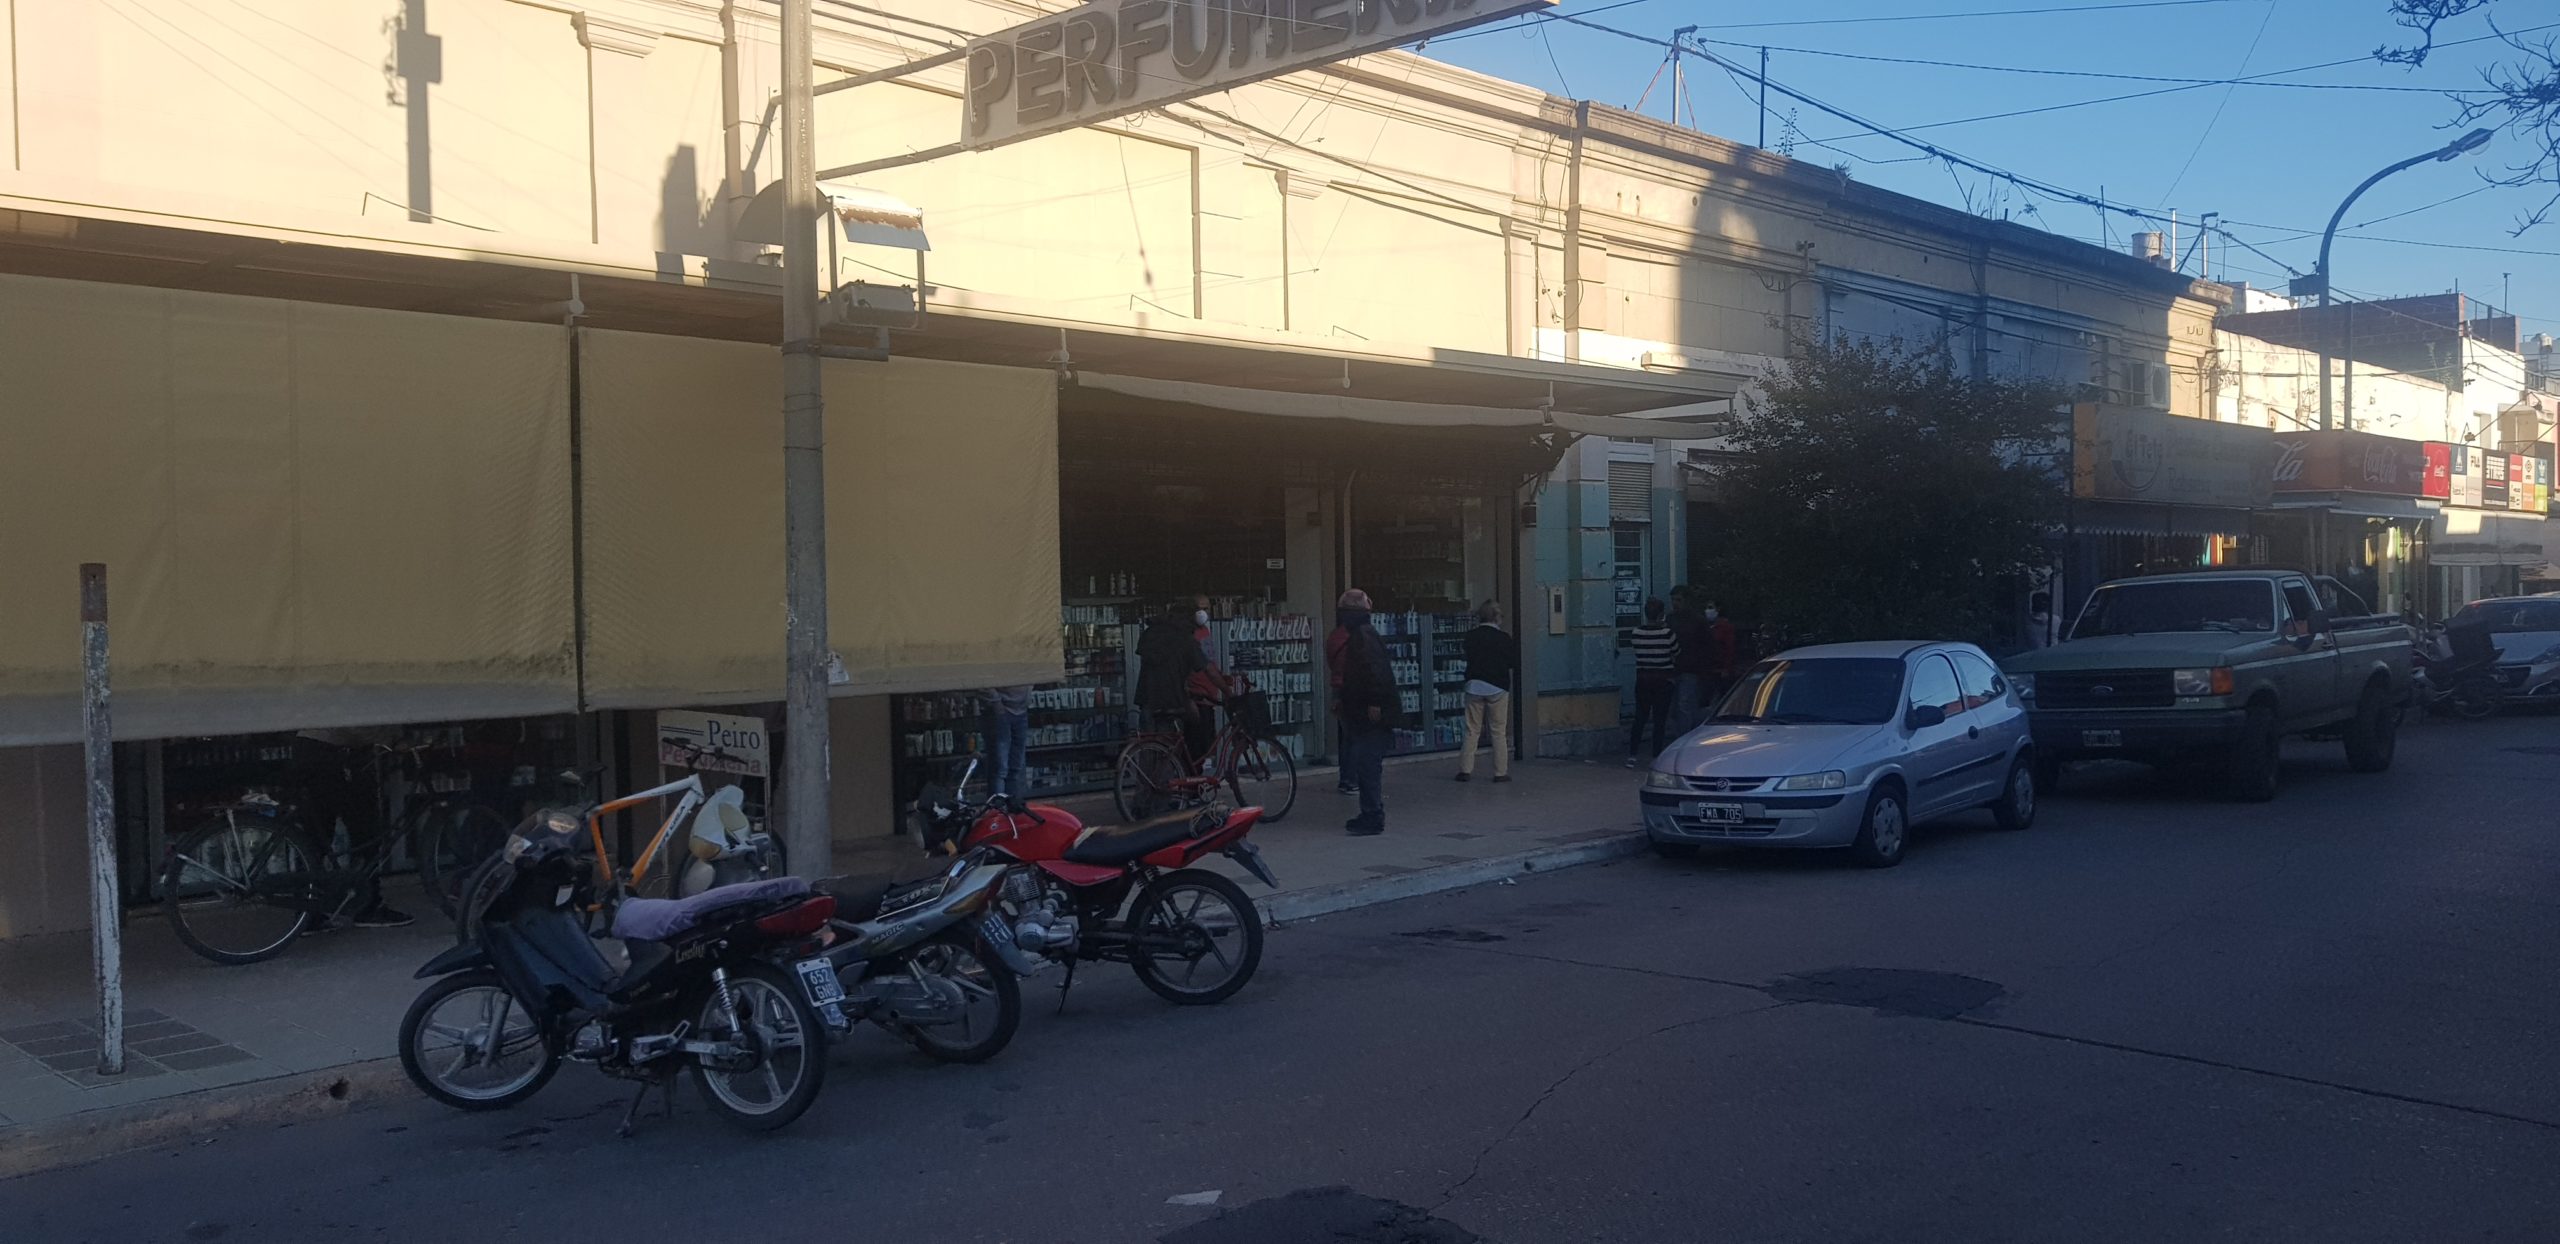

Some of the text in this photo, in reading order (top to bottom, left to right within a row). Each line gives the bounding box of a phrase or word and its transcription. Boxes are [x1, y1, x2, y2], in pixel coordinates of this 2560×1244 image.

[707, 719, 760, 749] Peiro
[1700, 808, 1741, 820] FMA 705
[810, 969, 830, 985] 652
